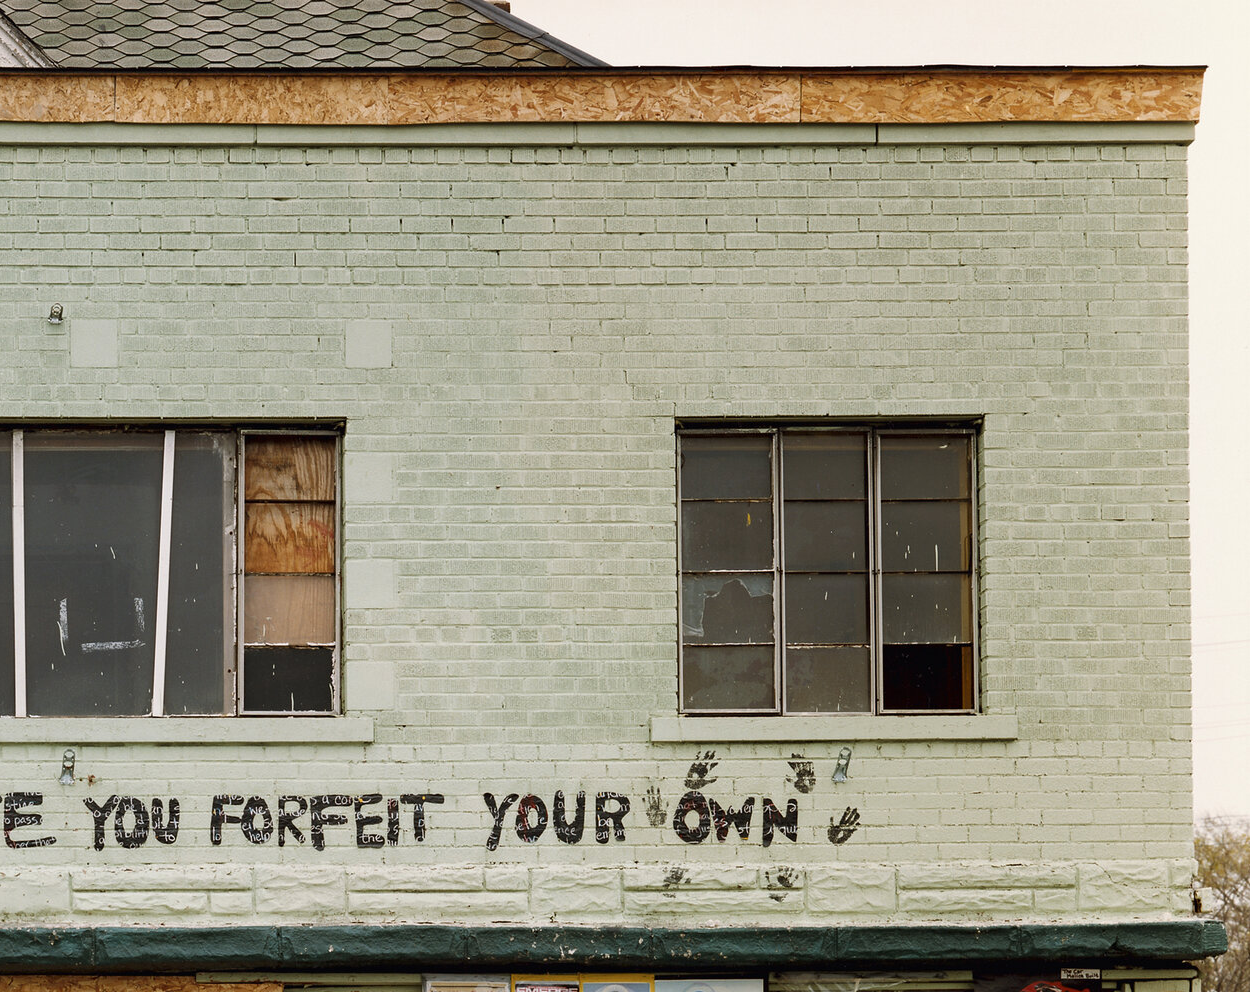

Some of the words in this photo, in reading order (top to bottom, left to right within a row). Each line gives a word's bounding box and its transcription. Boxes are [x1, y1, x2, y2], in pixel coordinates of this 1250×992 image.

[82, 793, 180, 852] YOU
[210, 791, 445, 851] FORFEIT
[483, 789, 631, 851] YOUR
[672, 791, 799, 846] OWN
